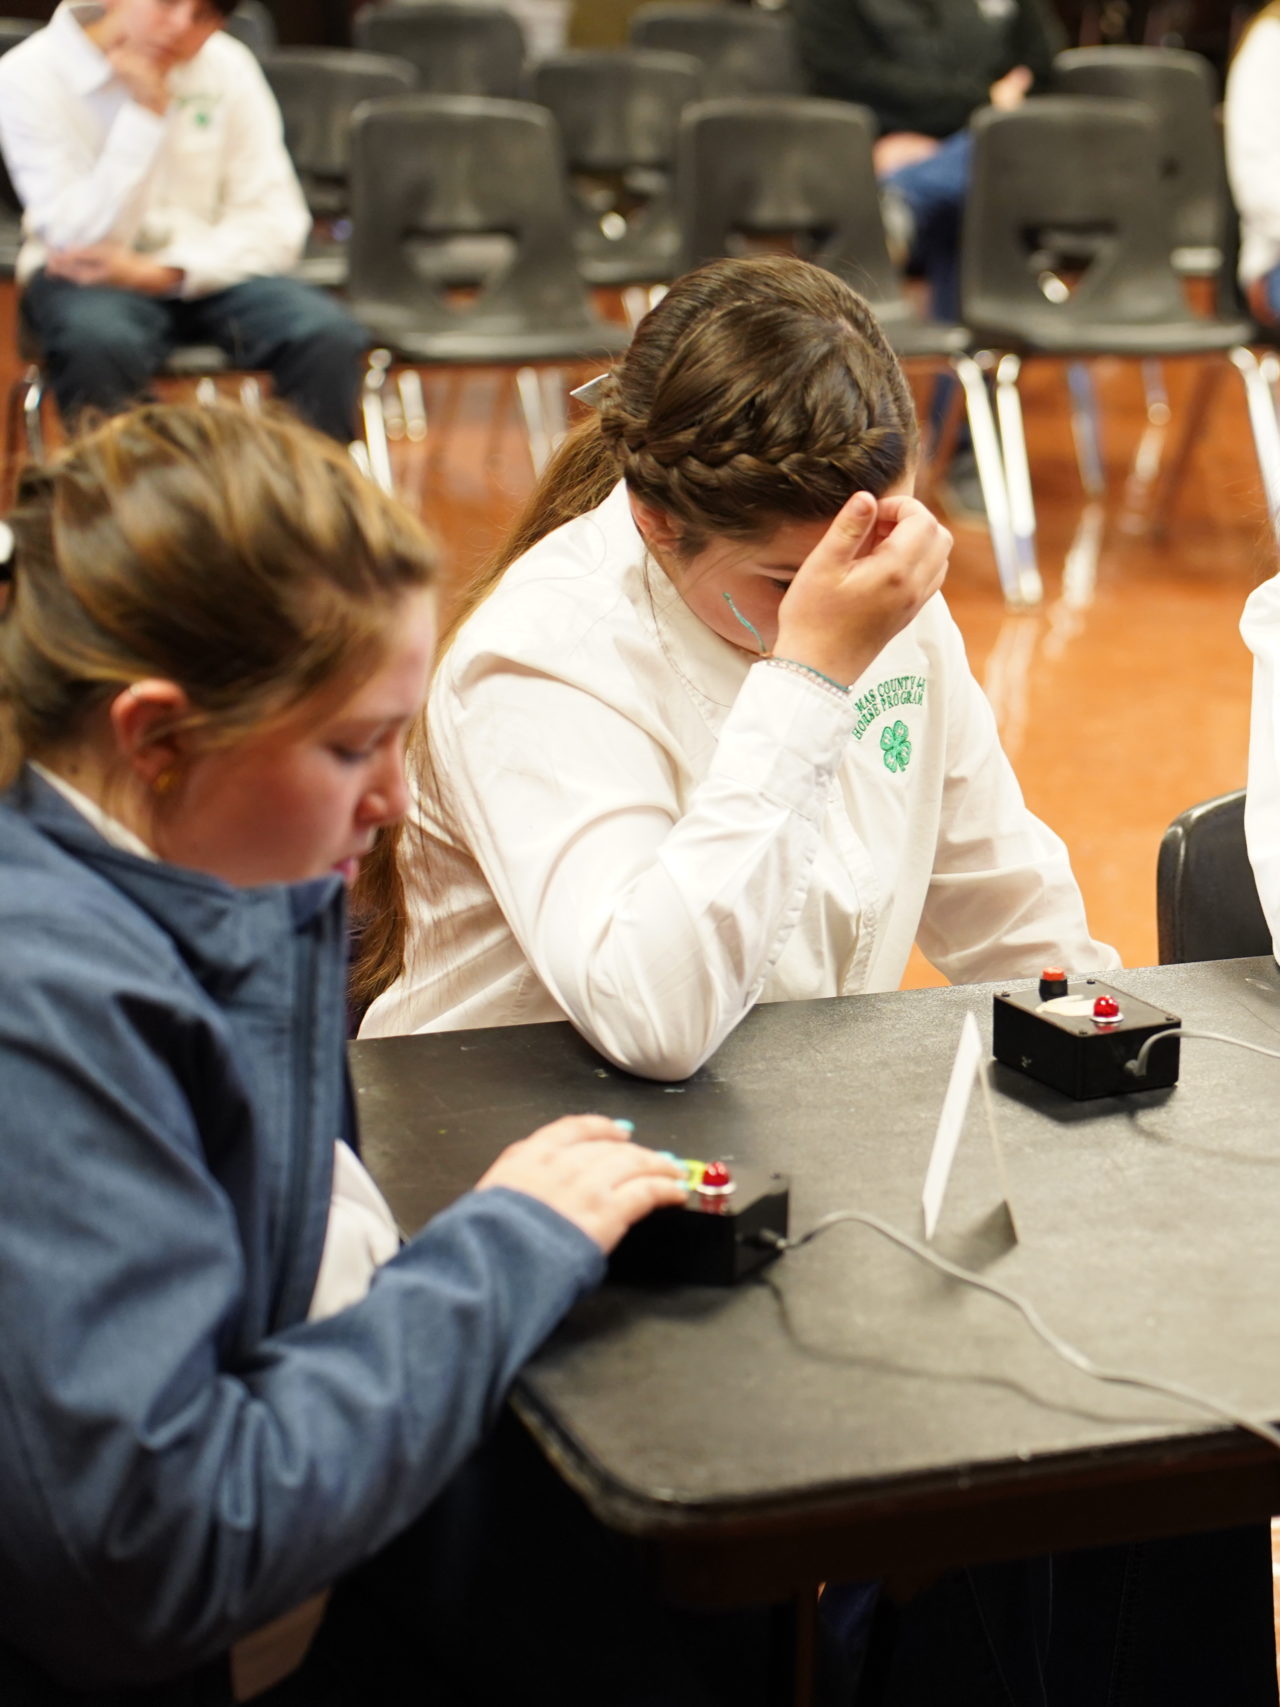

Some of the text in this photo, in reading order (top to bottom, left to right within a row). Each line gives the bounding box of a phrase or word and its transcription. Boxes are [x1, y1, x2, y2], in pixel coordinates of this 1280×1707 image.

[877, 676, 916, 698] COUNTY
[851, 690, 924, 740] HORSE PROGRAM
